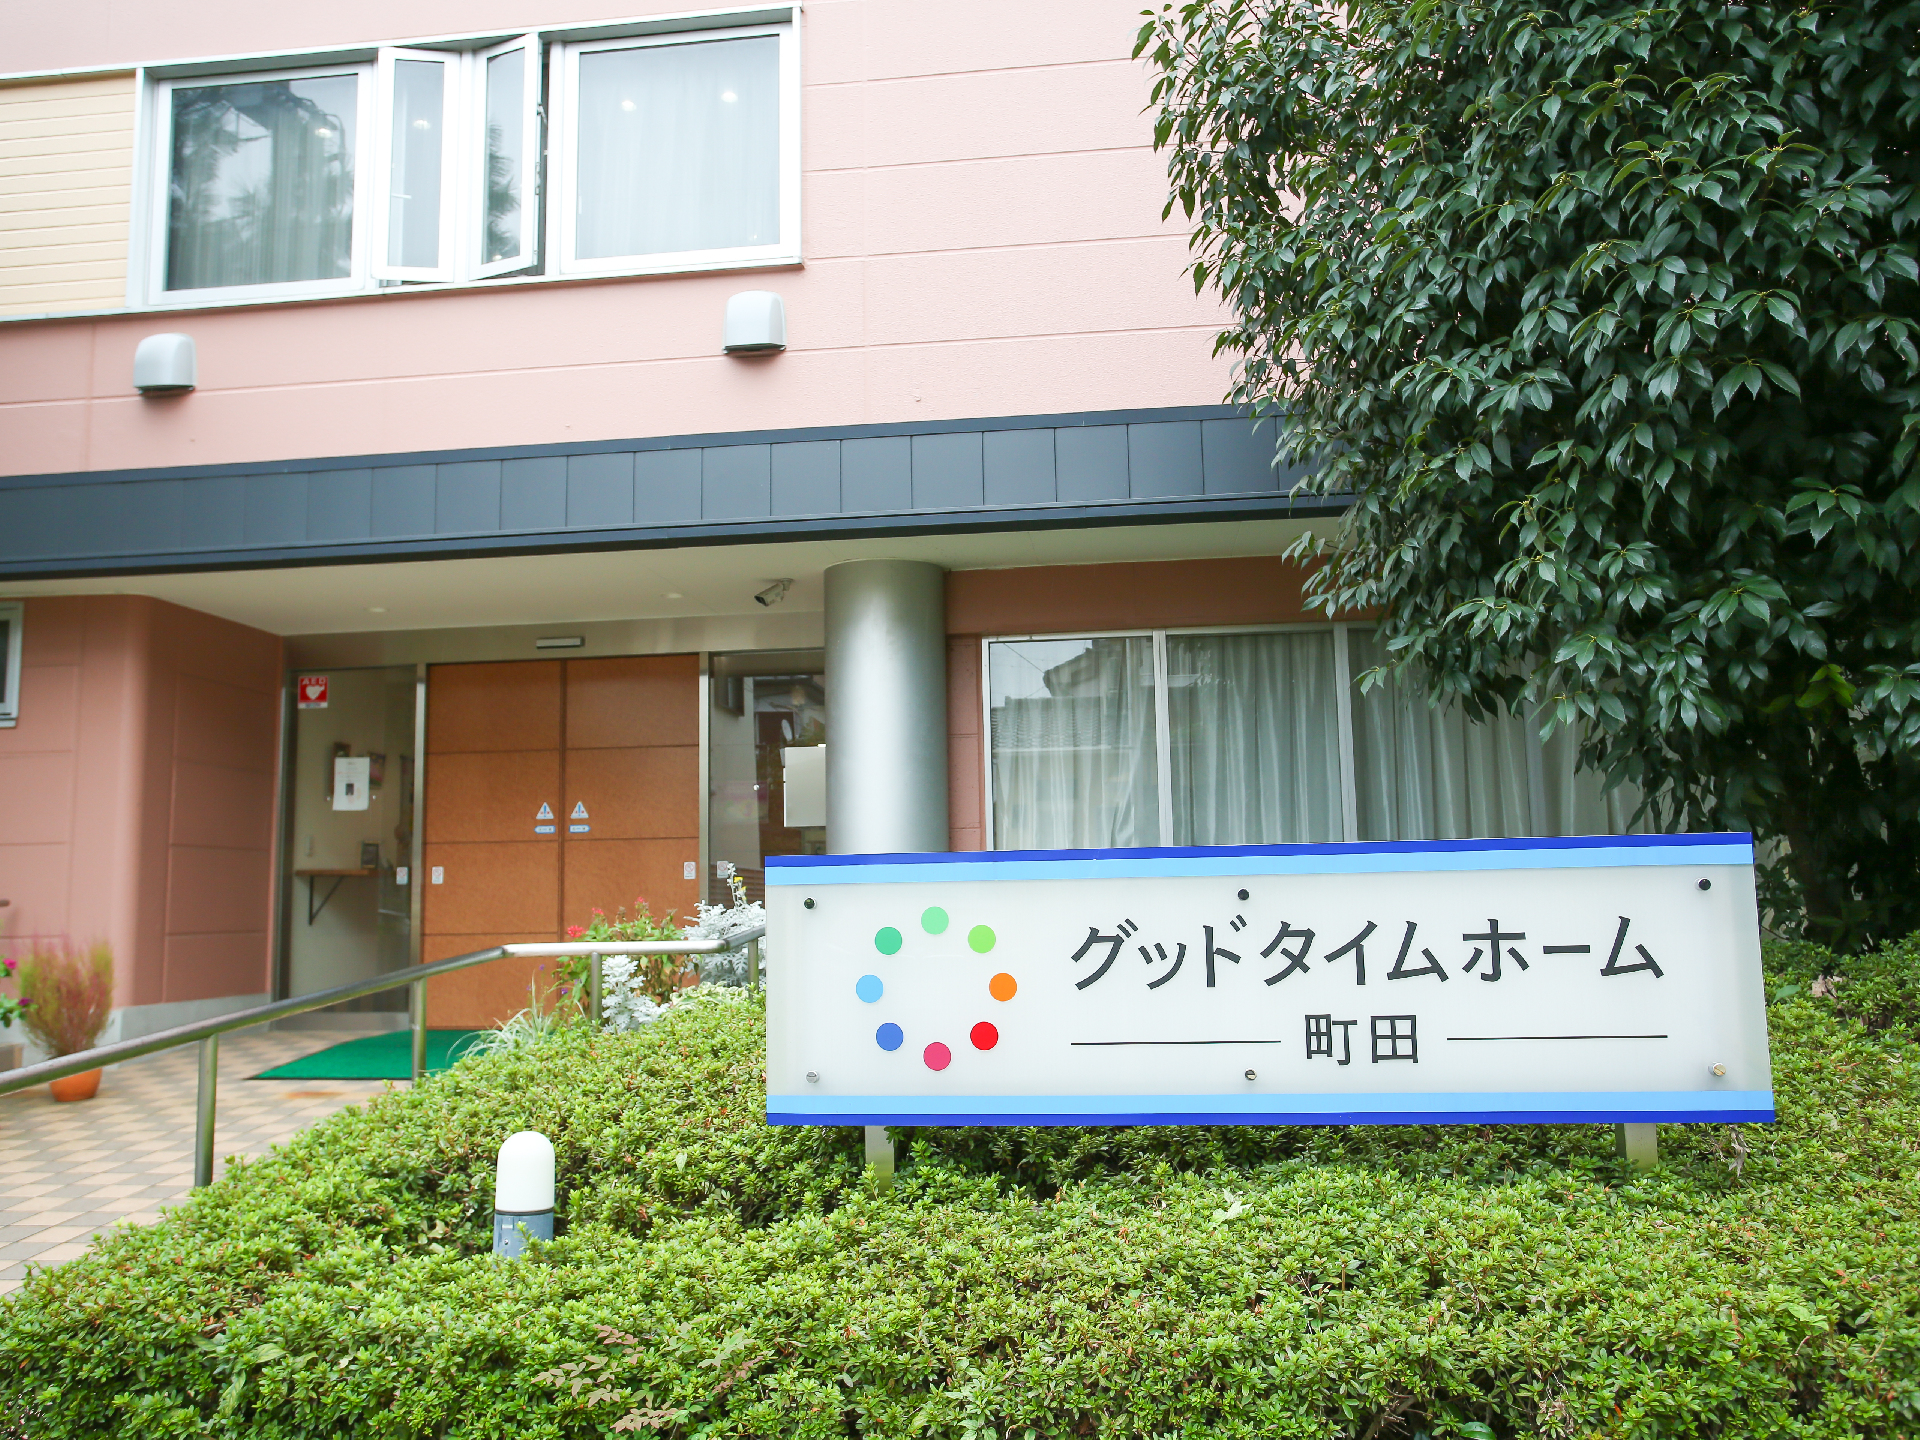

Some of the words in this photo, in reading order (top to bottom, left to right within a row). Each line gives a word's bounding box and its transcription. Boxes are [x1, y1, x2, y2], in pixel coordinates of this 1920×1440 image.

[302, 677, 325, 685] AED
[1071, 914, 1664, 991] グッドタイムホーム
[1305, 1014, 1418, 1066] 町田
